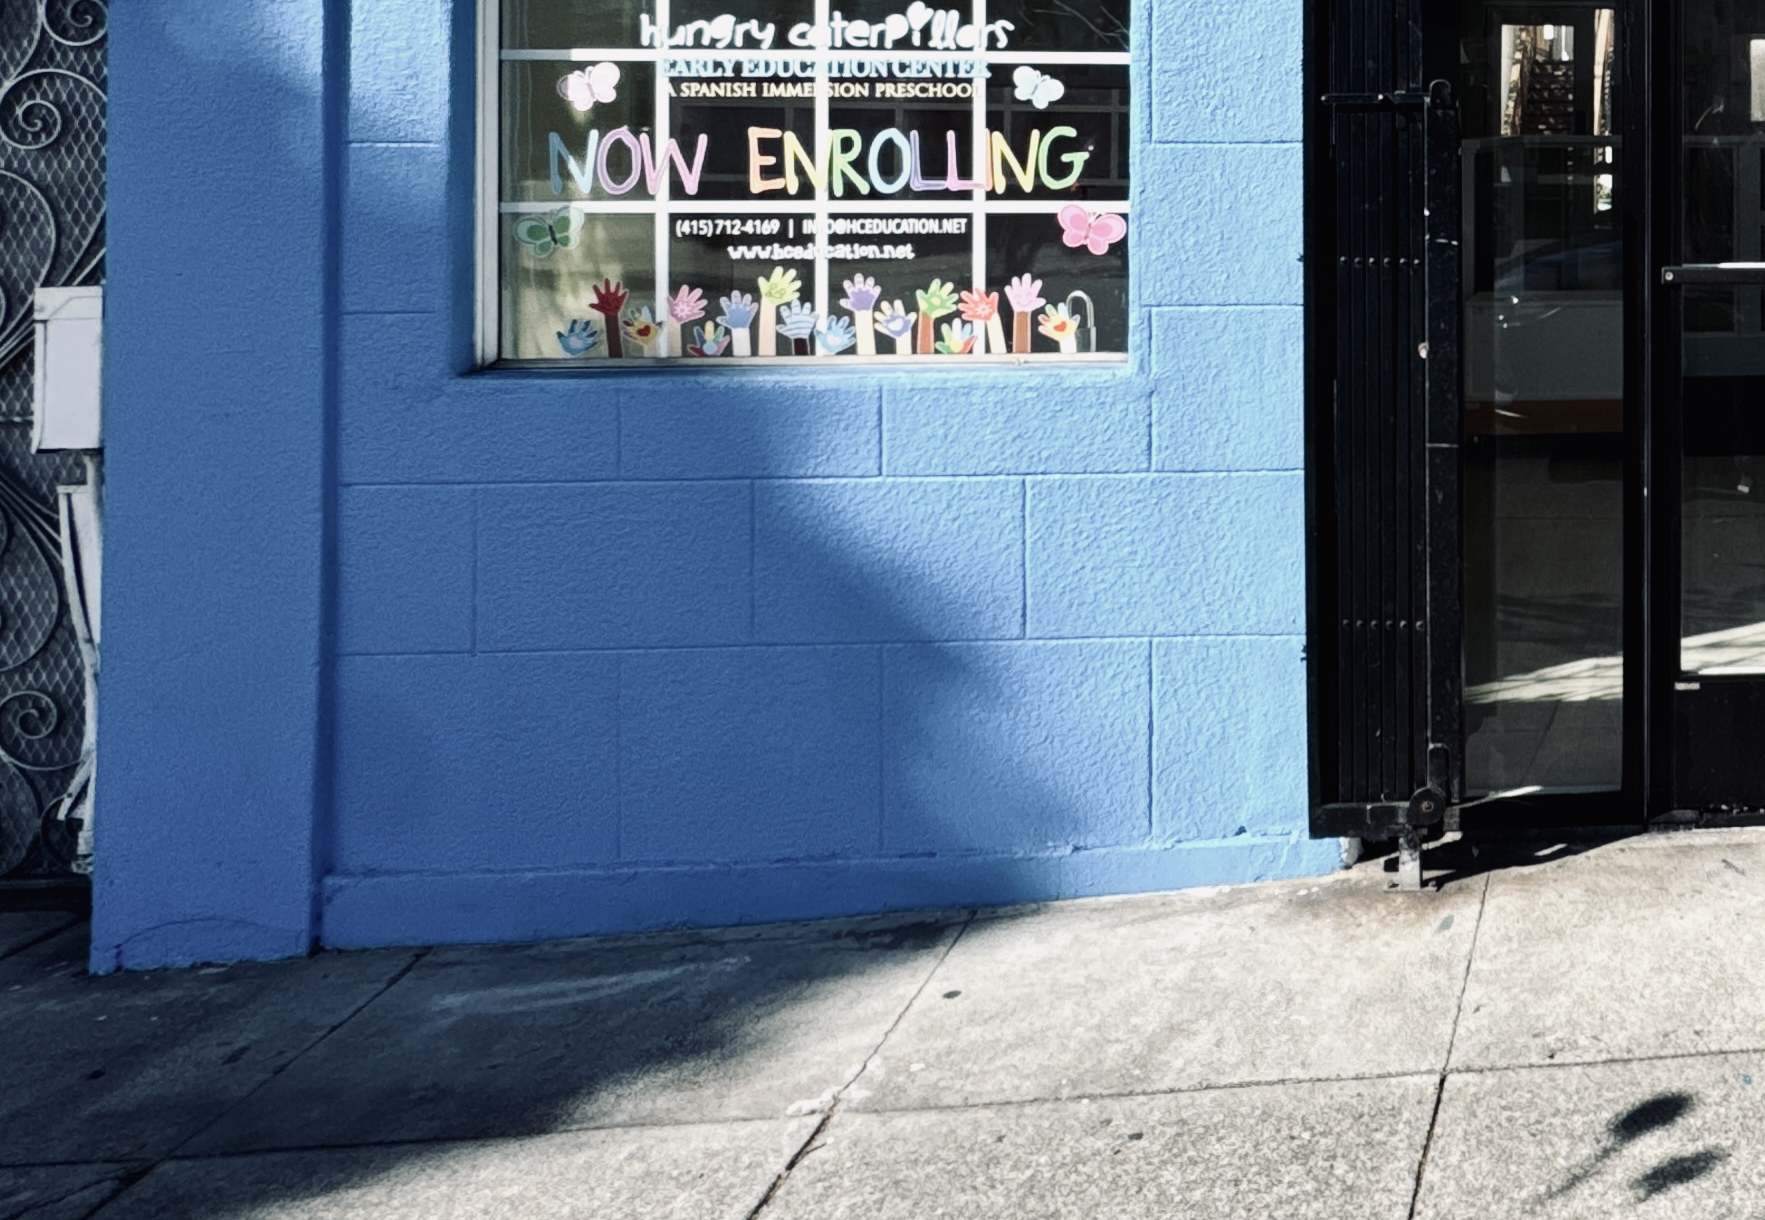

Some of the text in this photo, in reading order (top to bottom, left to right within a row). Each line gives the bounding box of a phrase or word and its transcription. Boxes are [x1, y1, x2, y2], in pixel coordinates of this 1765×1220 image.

[640, 0, 1015, 50] hungry caterpillars
[661, 58, 735, 77] EARLY
[892, 58, 992, 79] CENTER
[680, 82, 757, 98] SPANISH
[548, 126, 1088, 196] NOW ENROLLING
